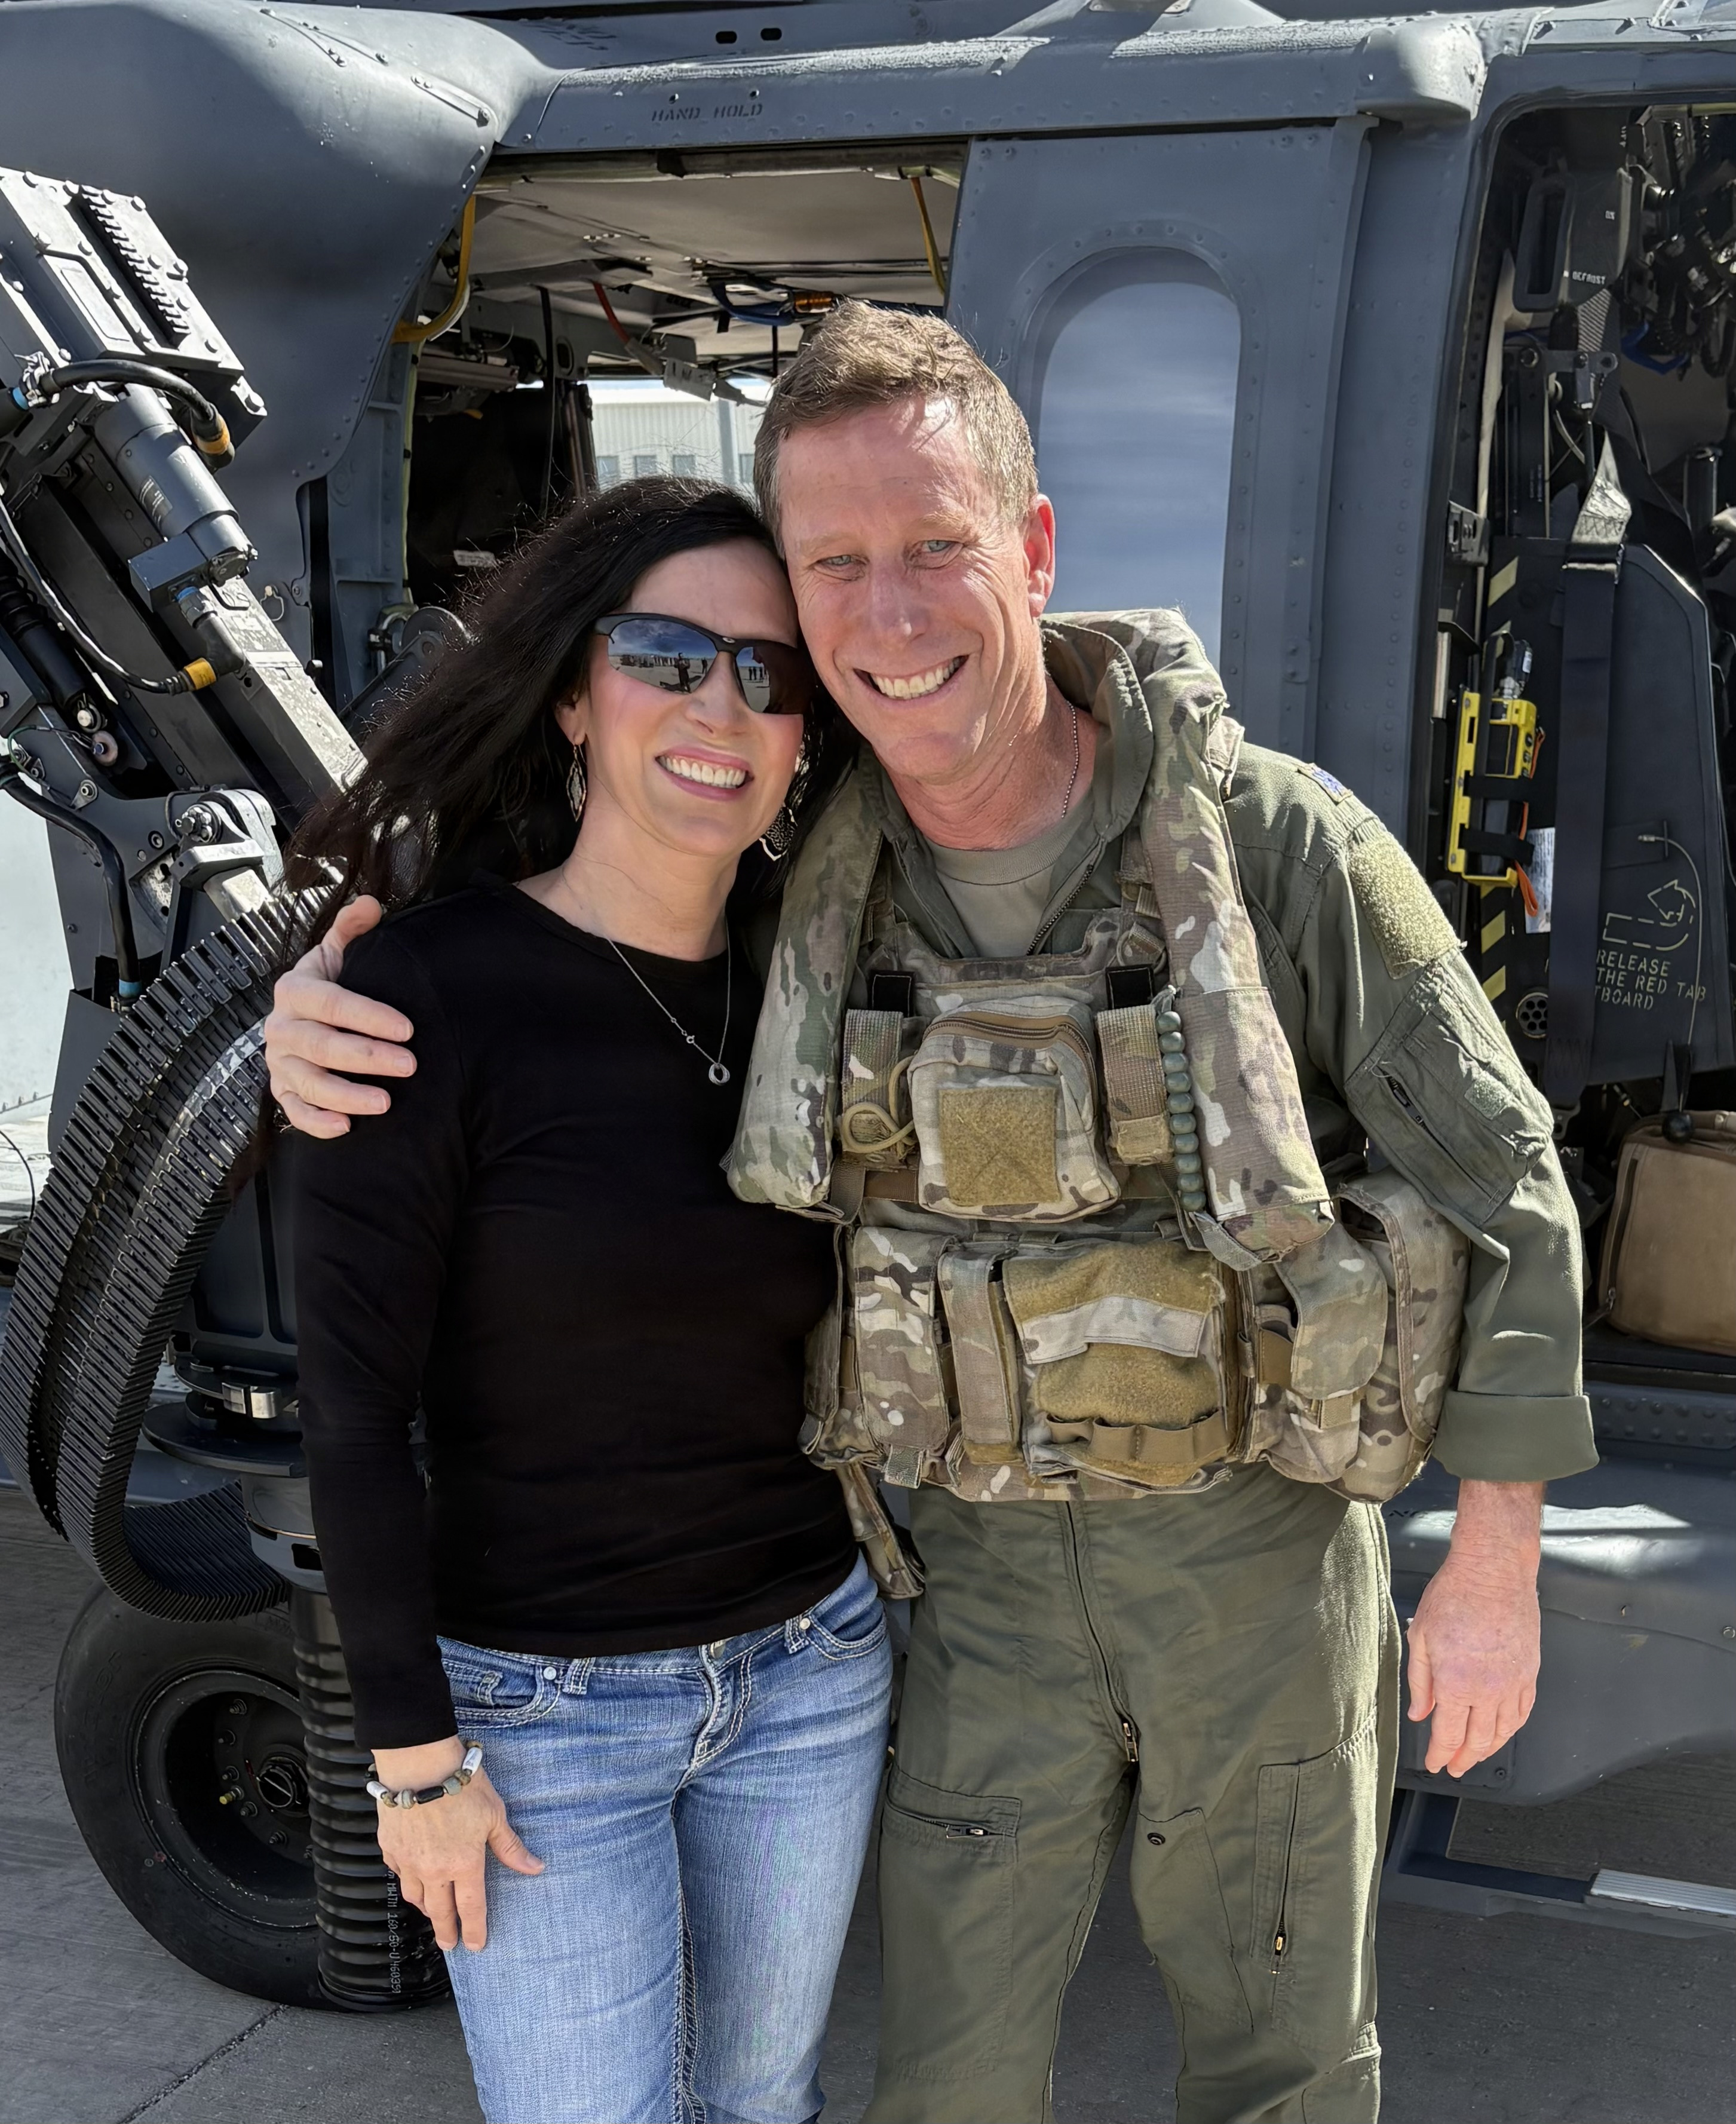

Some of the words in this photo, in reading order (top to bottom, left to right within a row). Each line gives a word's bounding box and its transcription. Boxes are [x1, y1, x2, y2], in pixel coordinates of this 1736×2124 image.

[651, 108, 701, 122] HAND
[714, 103, 763, 119] HOLD
[1596, 949, 1671, 977] RELEASE
[1596, 967, 1627, 987] THE
[1635, 974, 1667, 994] RED
[1677, 982, 1707, 1002] TAB
